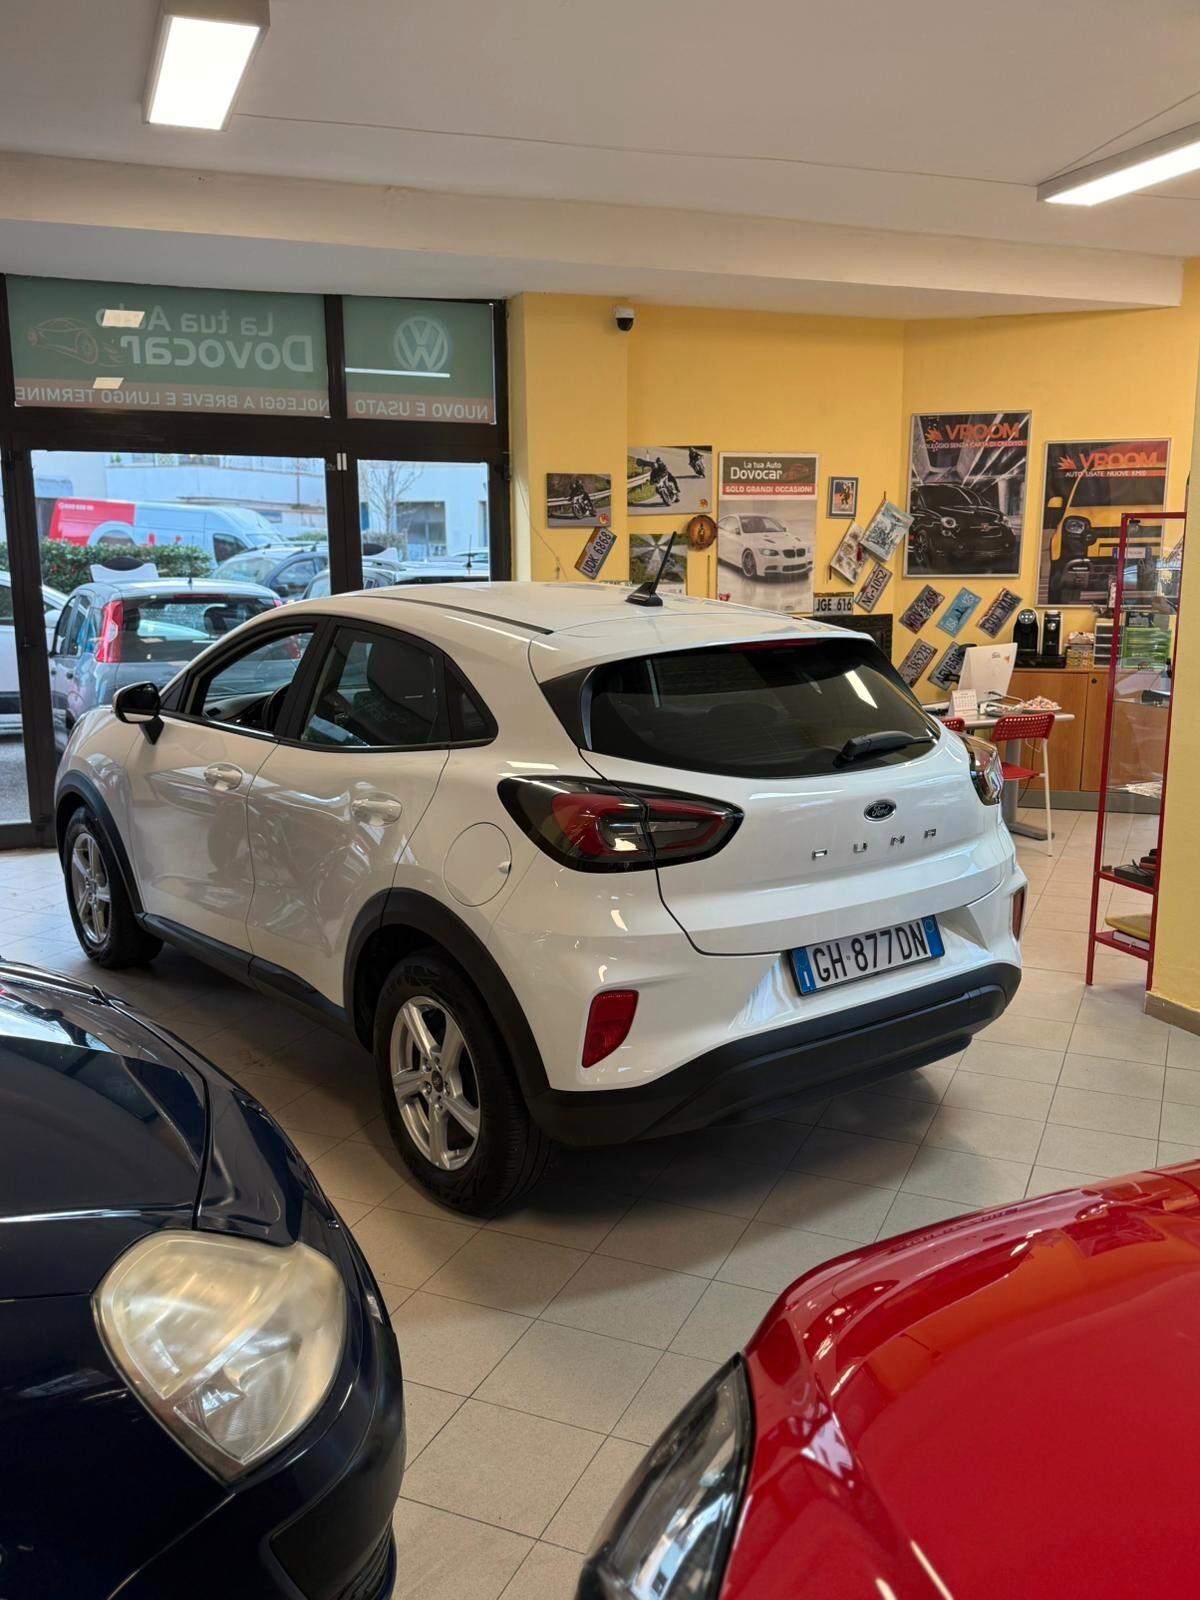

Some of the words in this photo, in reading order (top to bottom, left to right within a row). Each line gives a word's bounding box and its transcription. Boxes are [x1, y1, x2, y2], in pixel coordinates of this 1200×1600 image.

[945, 422, 1021, 440] VROOM
[744, 461, 752, 469] La
[753, 461, 765, 469] tua
[766, 461, 782, 469] Auto
[1079, 451, 1158, 469] VROOM
[730, 466, 783, 480] Dovocar
[726, 485, 745, 493] SOLO
[746, 485, 774, 493] GRANDI
[582, 553, 600, 574] UDK
[593, 531, 612, 555] 6868
[861, 568, 887, 608] NG-1052
[816, 599, 832, 611] JGE
[837, 598, 852, 611] 616
